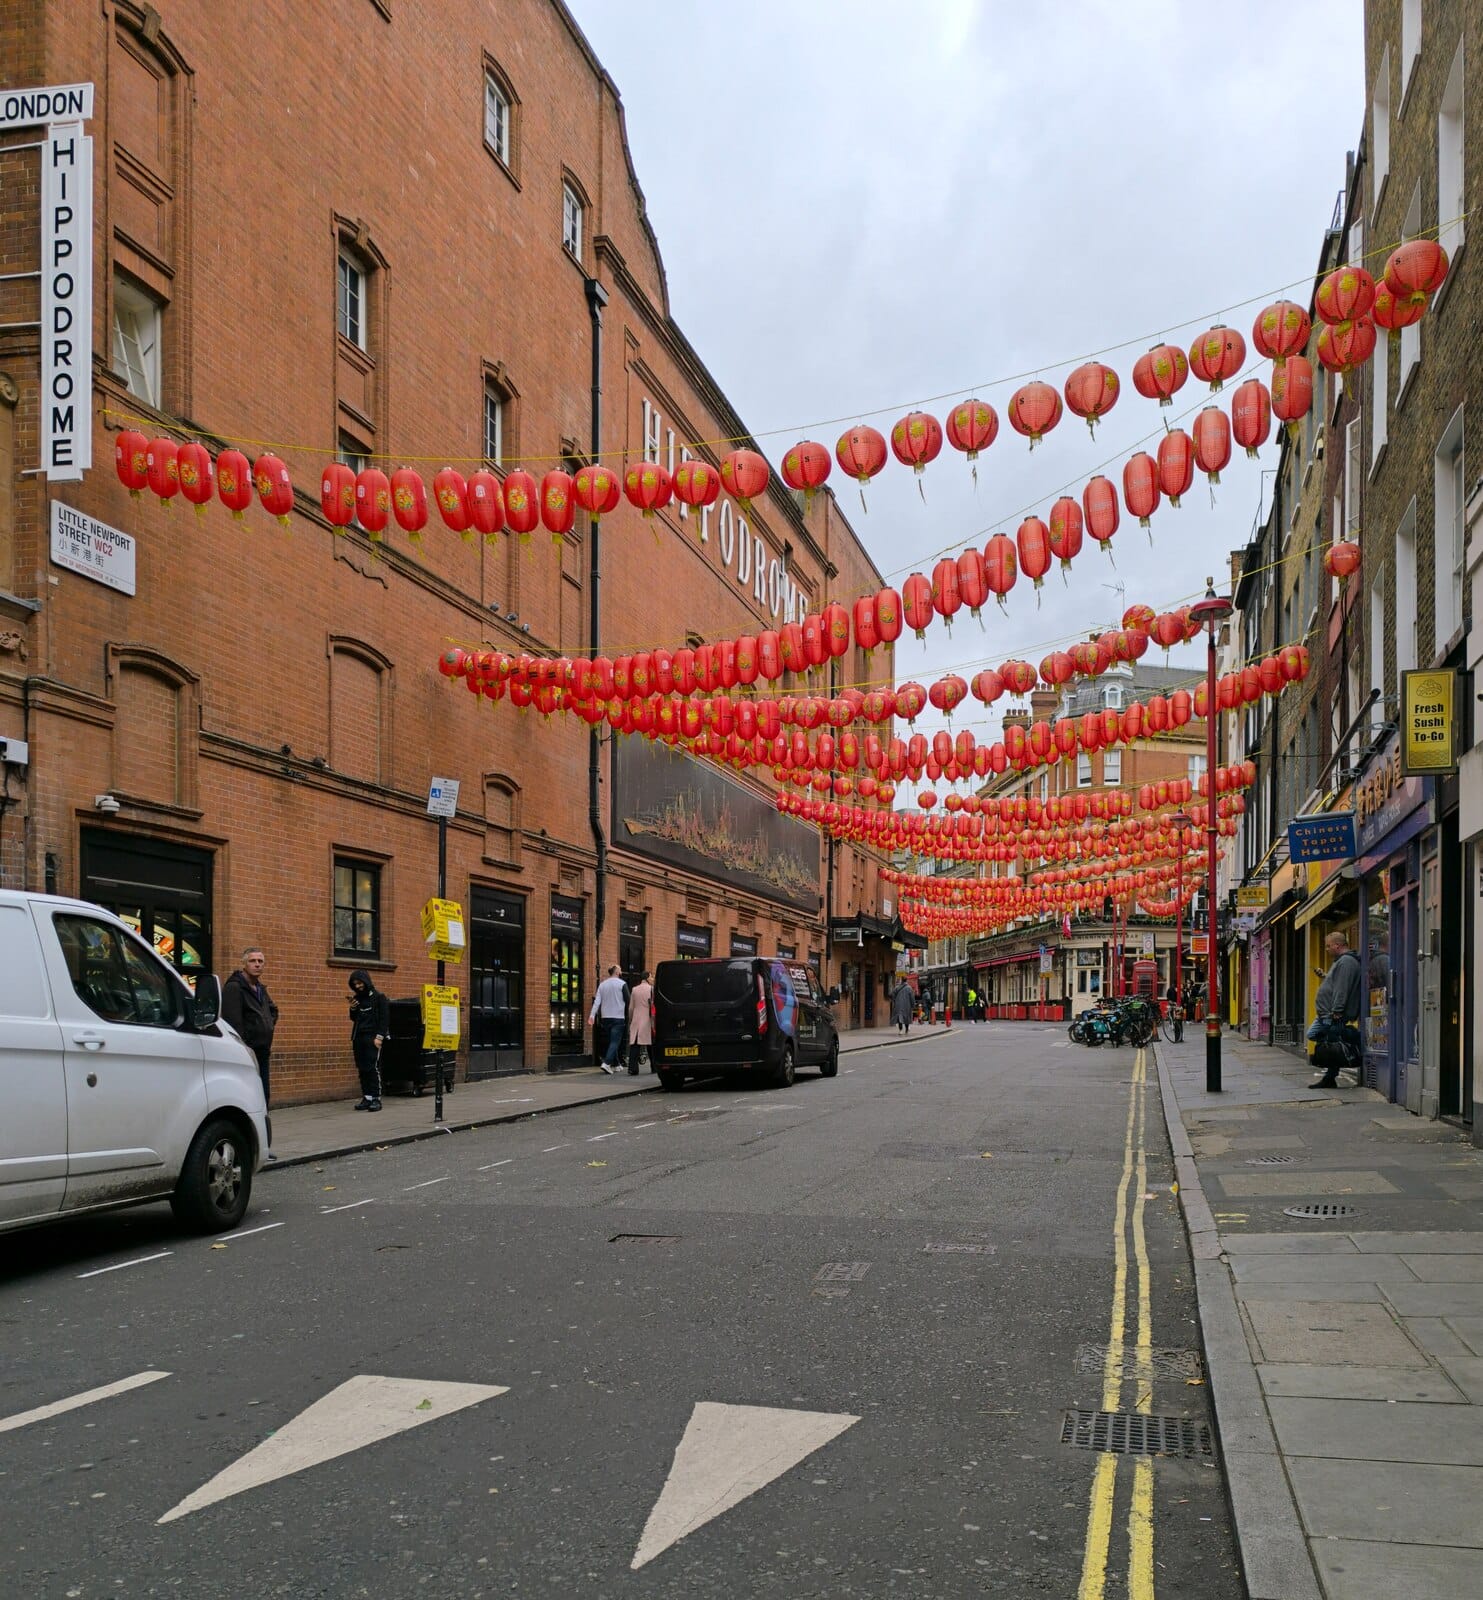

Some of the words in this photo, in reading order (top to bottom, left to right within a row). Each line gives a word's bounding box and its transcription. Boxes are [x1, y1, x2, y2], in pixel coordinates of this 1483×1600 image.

[52, 137, 75, 467] HIPPODROME
[58, 507, 87, 531] LITTLE
[90, 522, 131, 551] NEWPORT
[58, 522, 91, 547] STREET
[94, 538, 113, 557] WC2
[1414, 703, 1444, 713] Fresh
[1414, 717, 1444, 728] Sushi
[1414, 731, 1444, 742] To-Go
[1295, 825, 1348, 836] Chinese
[1302, 836, 1343, 847] Tapas
[1301, 845, 1347, 857] House
